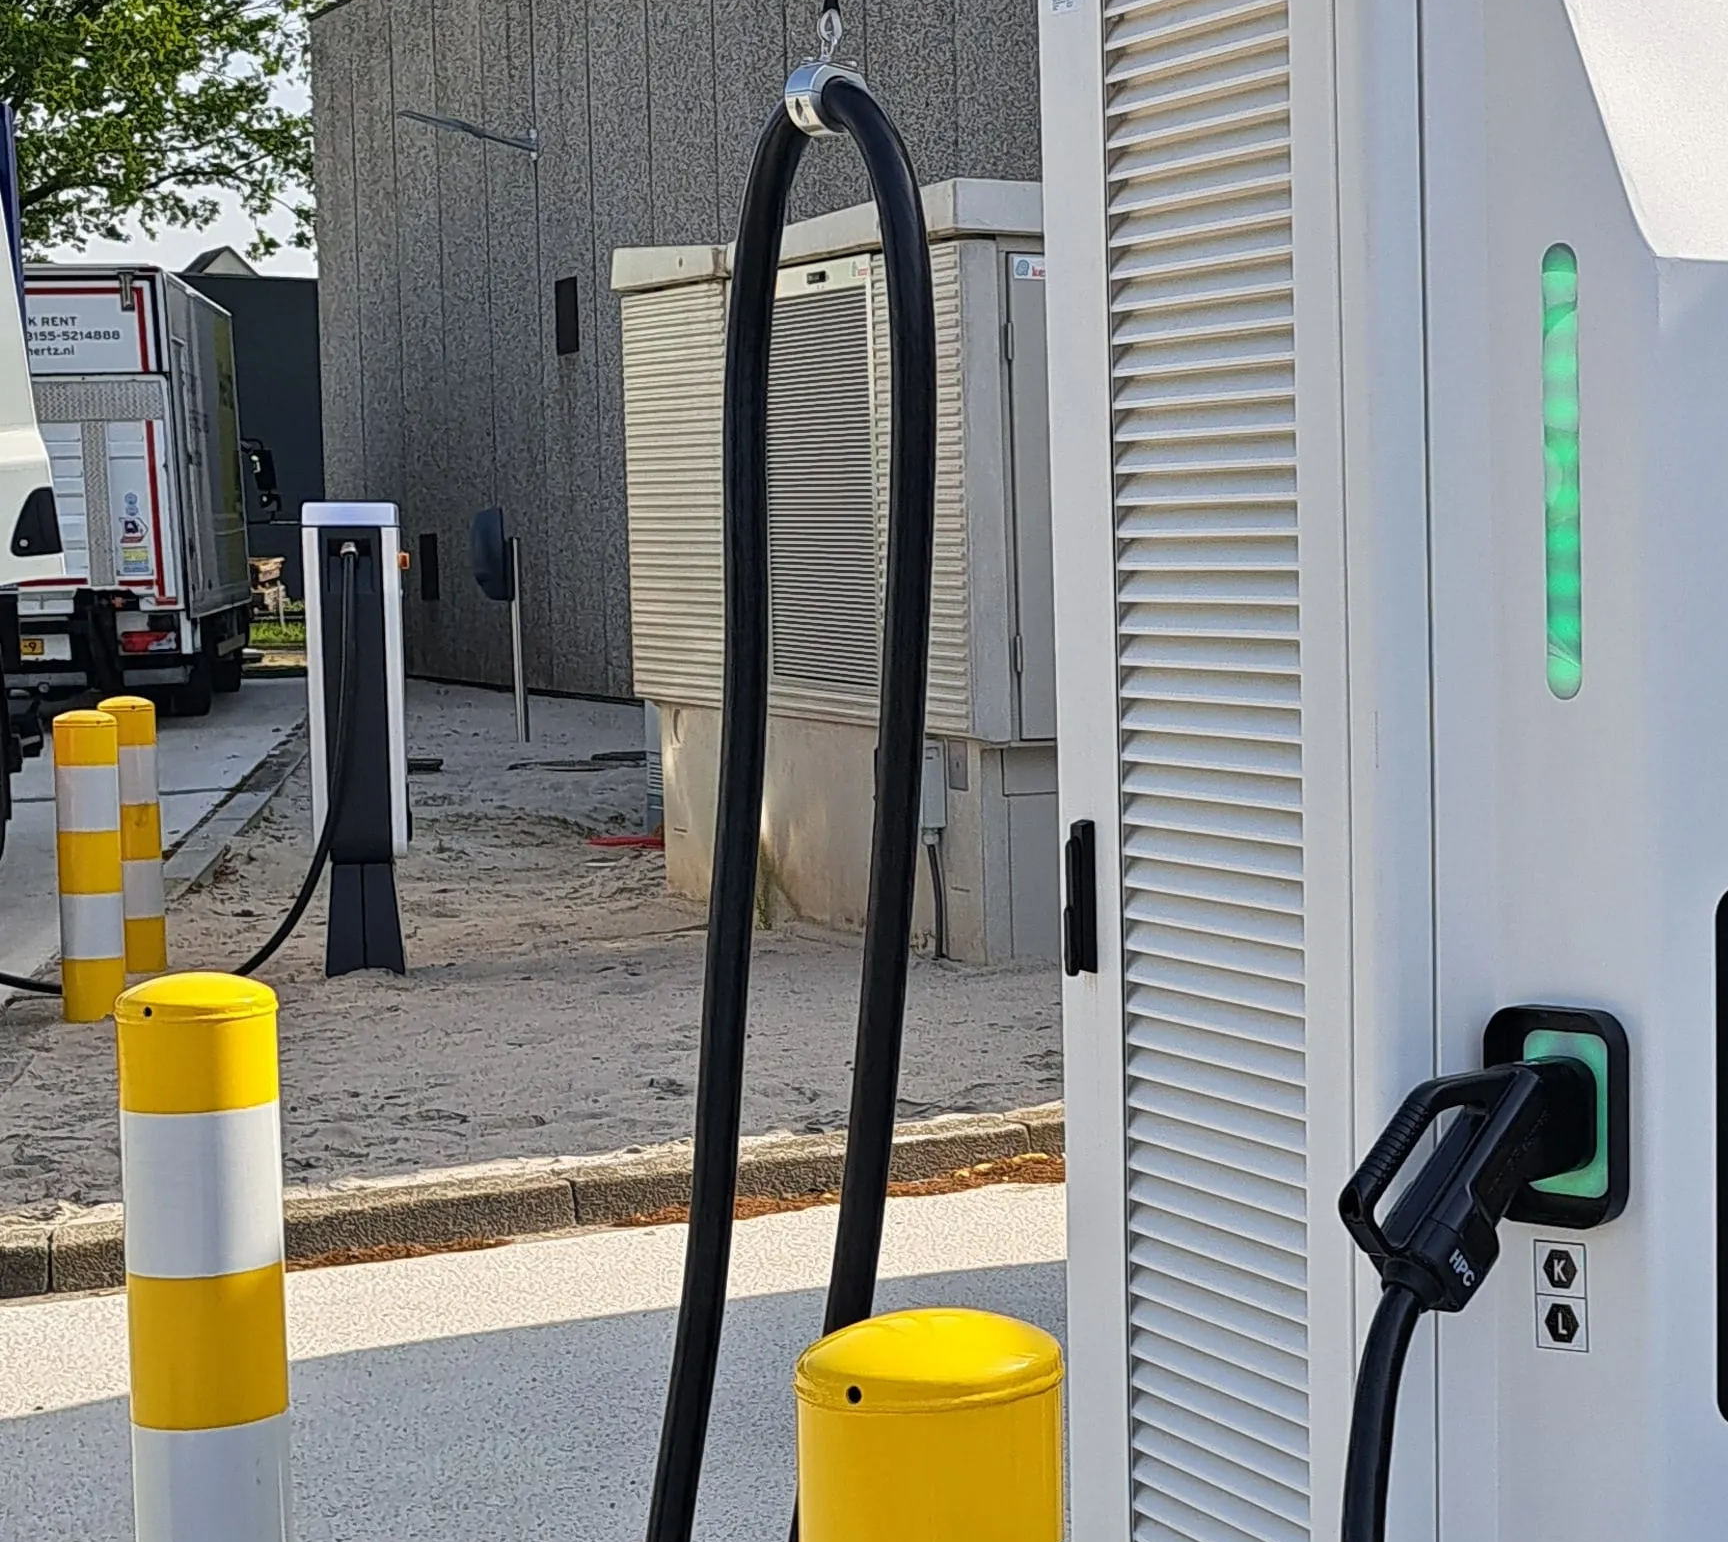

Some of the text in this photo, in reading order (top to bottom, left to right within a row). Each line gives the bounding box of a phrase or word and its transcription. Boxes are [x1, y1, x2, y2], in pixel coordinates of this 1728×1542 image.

[41, 316, 78, 327] RENT
[1449, 1248, 1475, 1287] HPC
[1553, 1259, 1568, 1283] K
[1557, 1312, 1568, 1335] L
